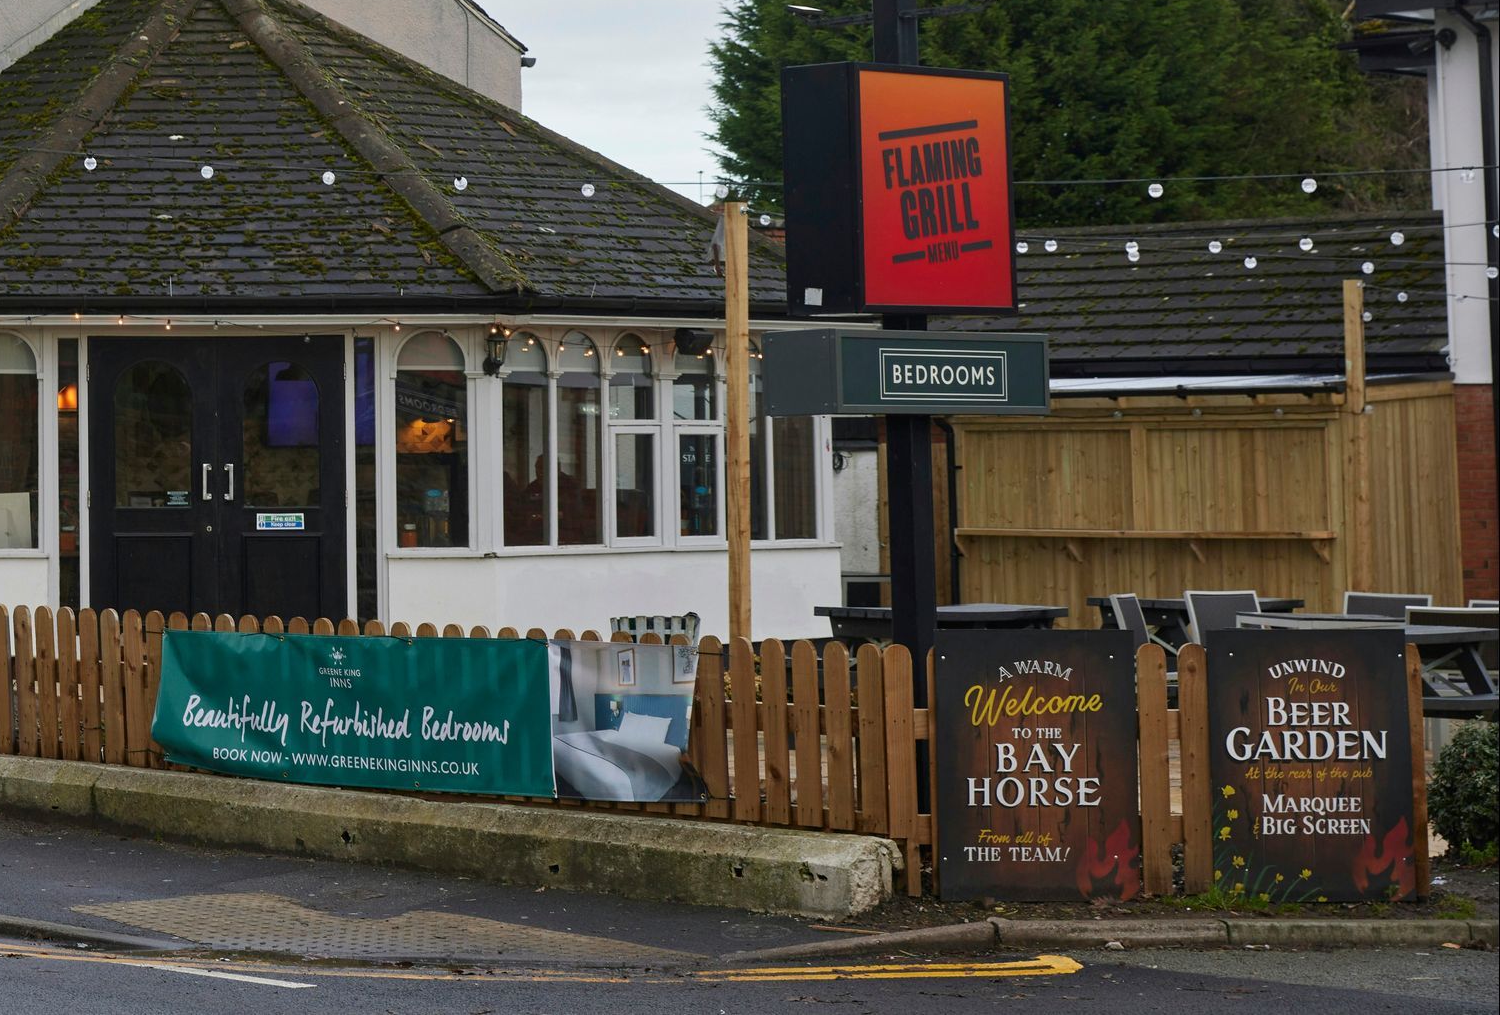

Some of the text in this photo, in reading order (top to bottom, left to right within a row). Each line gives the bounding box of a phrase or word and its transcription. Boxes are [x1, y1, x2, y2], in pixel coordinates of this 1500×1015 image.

[882, 137, 982, 189] FLAMING
[900, 182, 979, 240] GRILL
[927, 241, 959, 264] MENU
[892, 364, 995, 386] BEDROOMS
[682, 454, 711, 463] STAE
[318, 667, 361, 677] GREENE KING
[999, 659, 1073, 683] A WARM
[1268, 658, 1346, 679] UNWIND
[329, 678, 352, 689] INNS
[1288, 677, 1338, 694] In Our
[964, 685, 1104, 727] Welcome
[1266, 696, 1351, 726] BEER
[182, 694, 509, 748] Beautifully Refurbished Bedrooms
[1012, 727, 1062, 739] TO THE
[1226, 727, 1388, 761] GARDEN
[213, 747, 248, 762] BOOK
[250, 750, 282, 763] NOW
[291, 753, 480, 775] WWW.GREENEKINGINNS.CO.UK
[995, 743, 1081, 773] BAY
[1245, 766, 1373, 782] At the rear of the pub
[967, 777, 1102, 807] HORSE
[1262, 793, 1361, 815] MARQUEE
[1262, 816, 1297, 835] BIG
[1303, 816, 1371, 835] SCREEN
[978, 829, 1052, 846] From all of
[964, 847, 1071, 862] THE TEAM!
